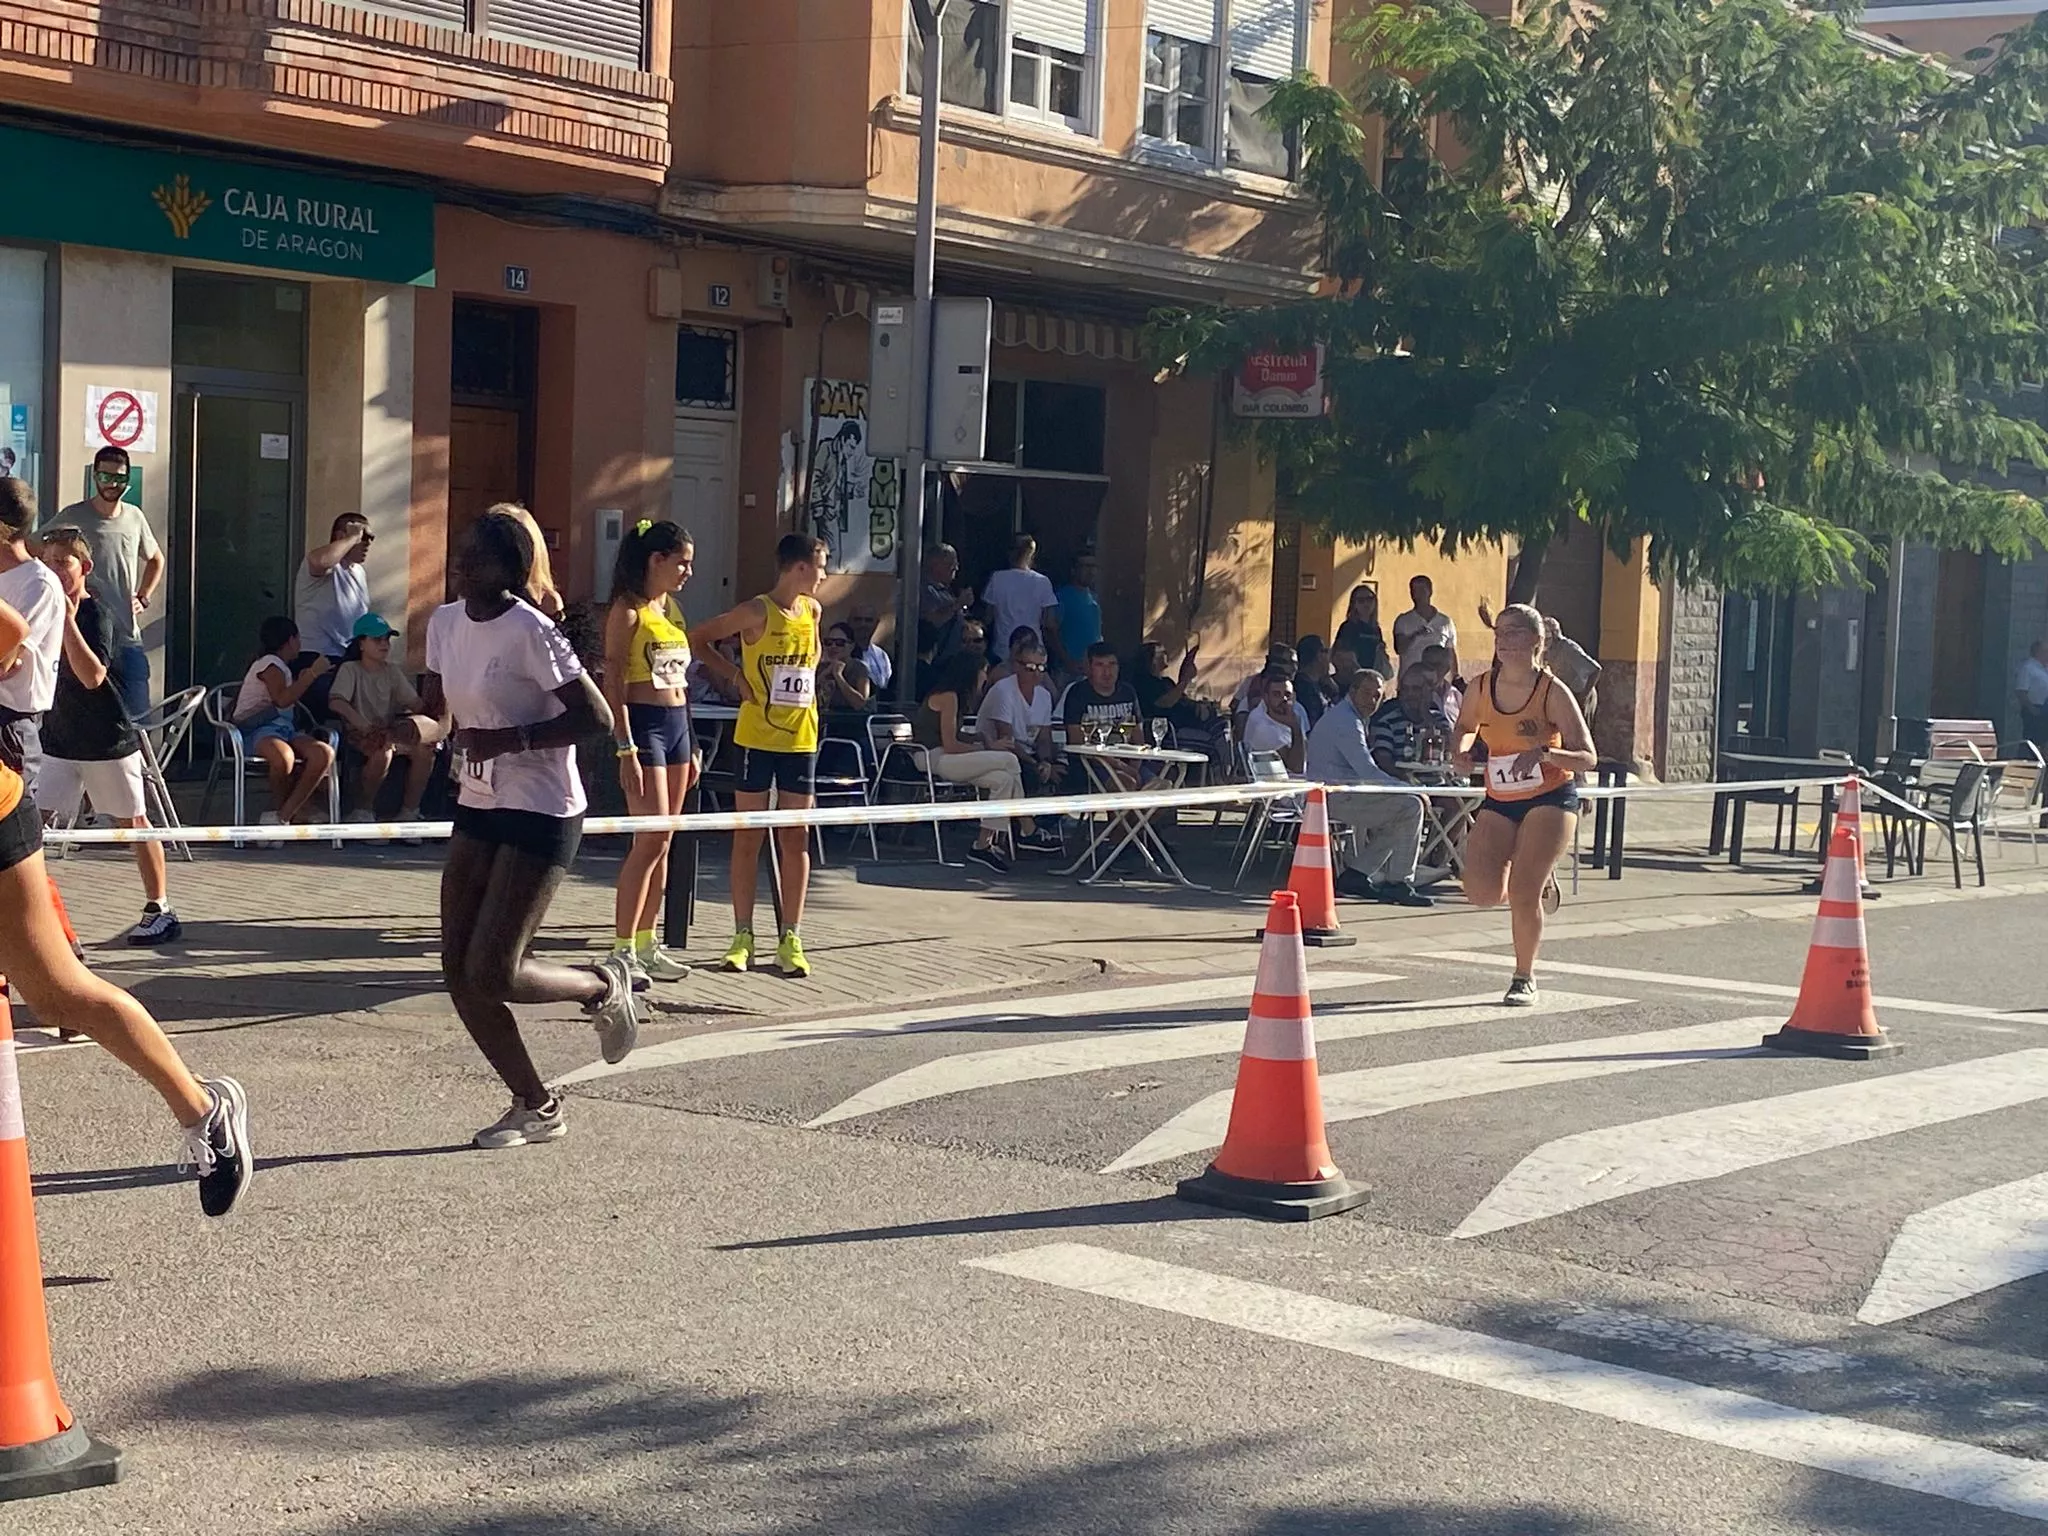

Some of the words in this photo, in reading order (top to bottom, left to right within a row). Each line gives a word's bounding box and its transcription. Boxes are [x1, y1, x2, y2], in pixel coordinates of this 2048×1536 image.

[223, 187, 289, 222] CAJA
[297, 198, 380, 234] RURAL
[242, 227, 269, 250] DE
[510, 268, 525, 289] 14
[715, 287, 729, 305] 12
[782, 677, 810, 693] 103
[1087, 702, 1134, 719] RAMONES
